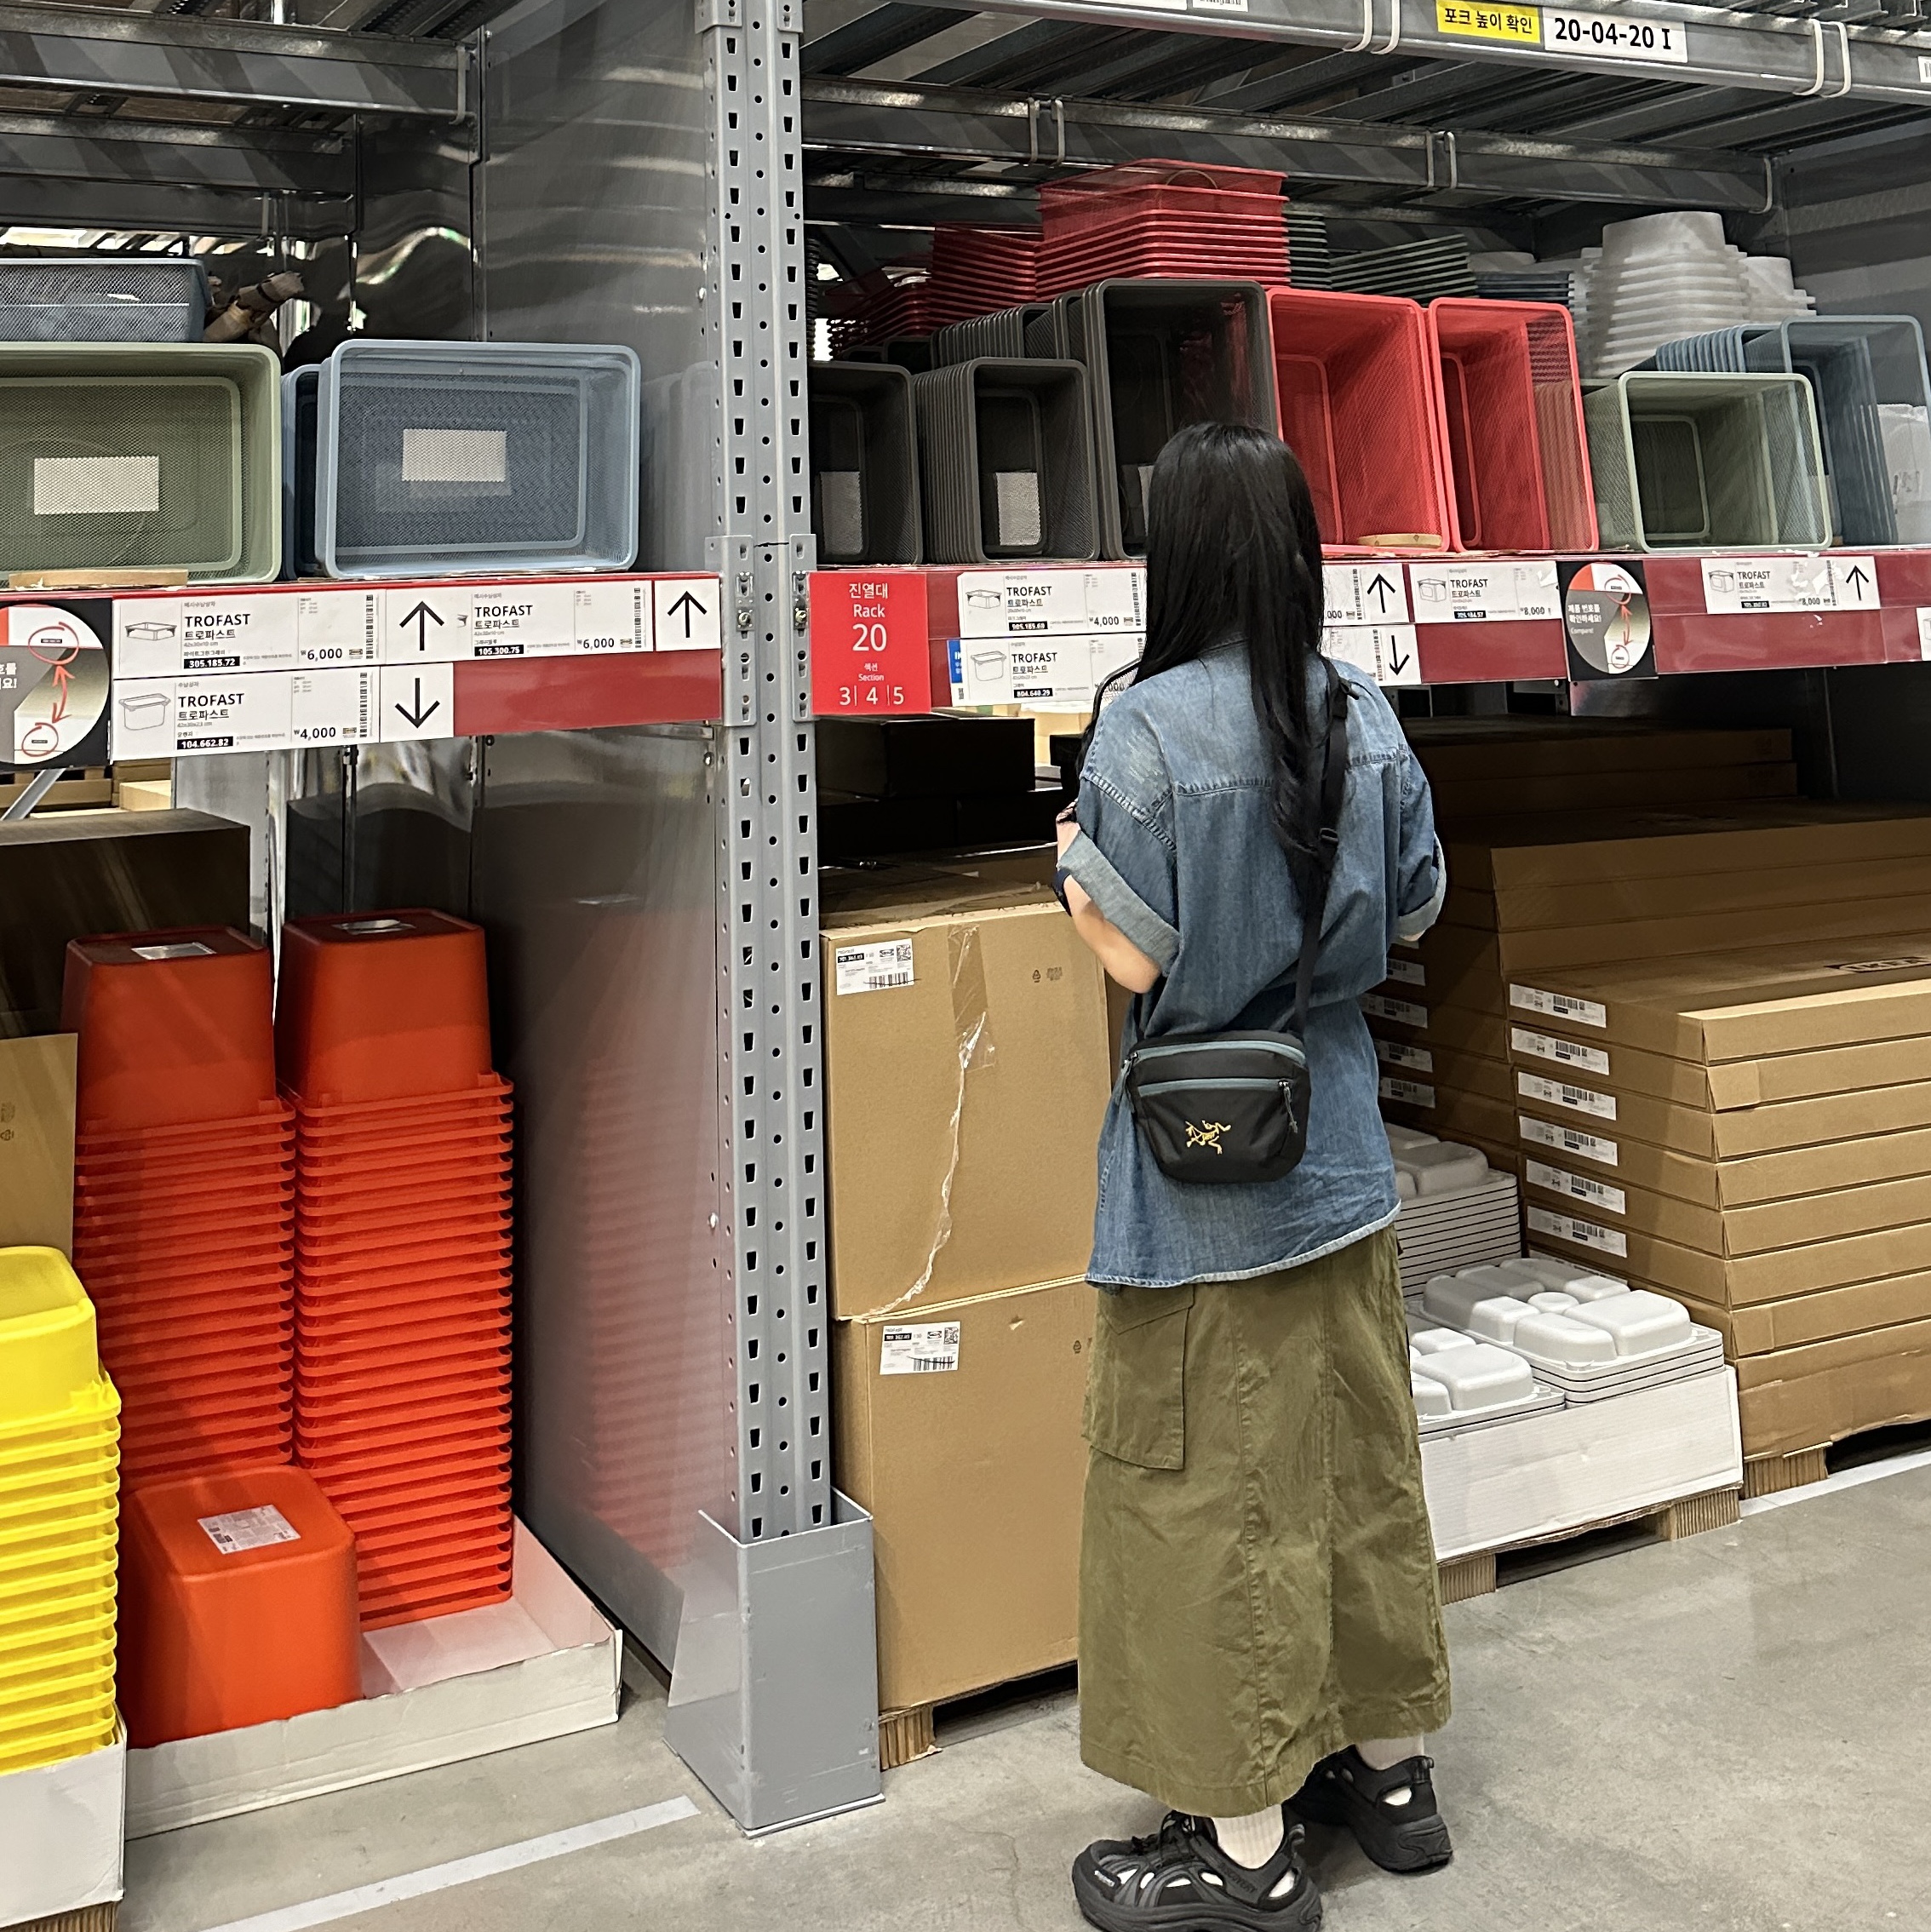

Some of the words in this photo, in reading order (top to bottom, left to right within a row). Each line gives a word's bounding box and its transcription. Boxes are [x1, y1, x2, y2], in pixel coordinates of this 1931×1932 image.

[1445, 8, 1471, 25] 포크
[1475, 11, 1502, 31] 높이
[1506, 14, 1533, 34] 확인
[1555, 18, 1654, 49] 20-04-20
[1450, 579, 1488, 588] TROFAST
[849, 582, 888, 599] 진열대
[1006, 586, 1052, 596] TROFAST
[474, 605, 533, 617] TROFAST
[853, 604, 885, 618] Rack
[185, 614, 250, 628] TROFAST
[474, 619, 519, 629] 트로파스트
[184, 629, 236, 640] 트로파스트
[852, 623, 887, 651] 20
[1011, 652, 1057, 663] TROFAST
[858, 674, 885, 682] Section
[178, 693, 244, 708] TROFAST
[177, 709, 229, 720] 트로파스트
